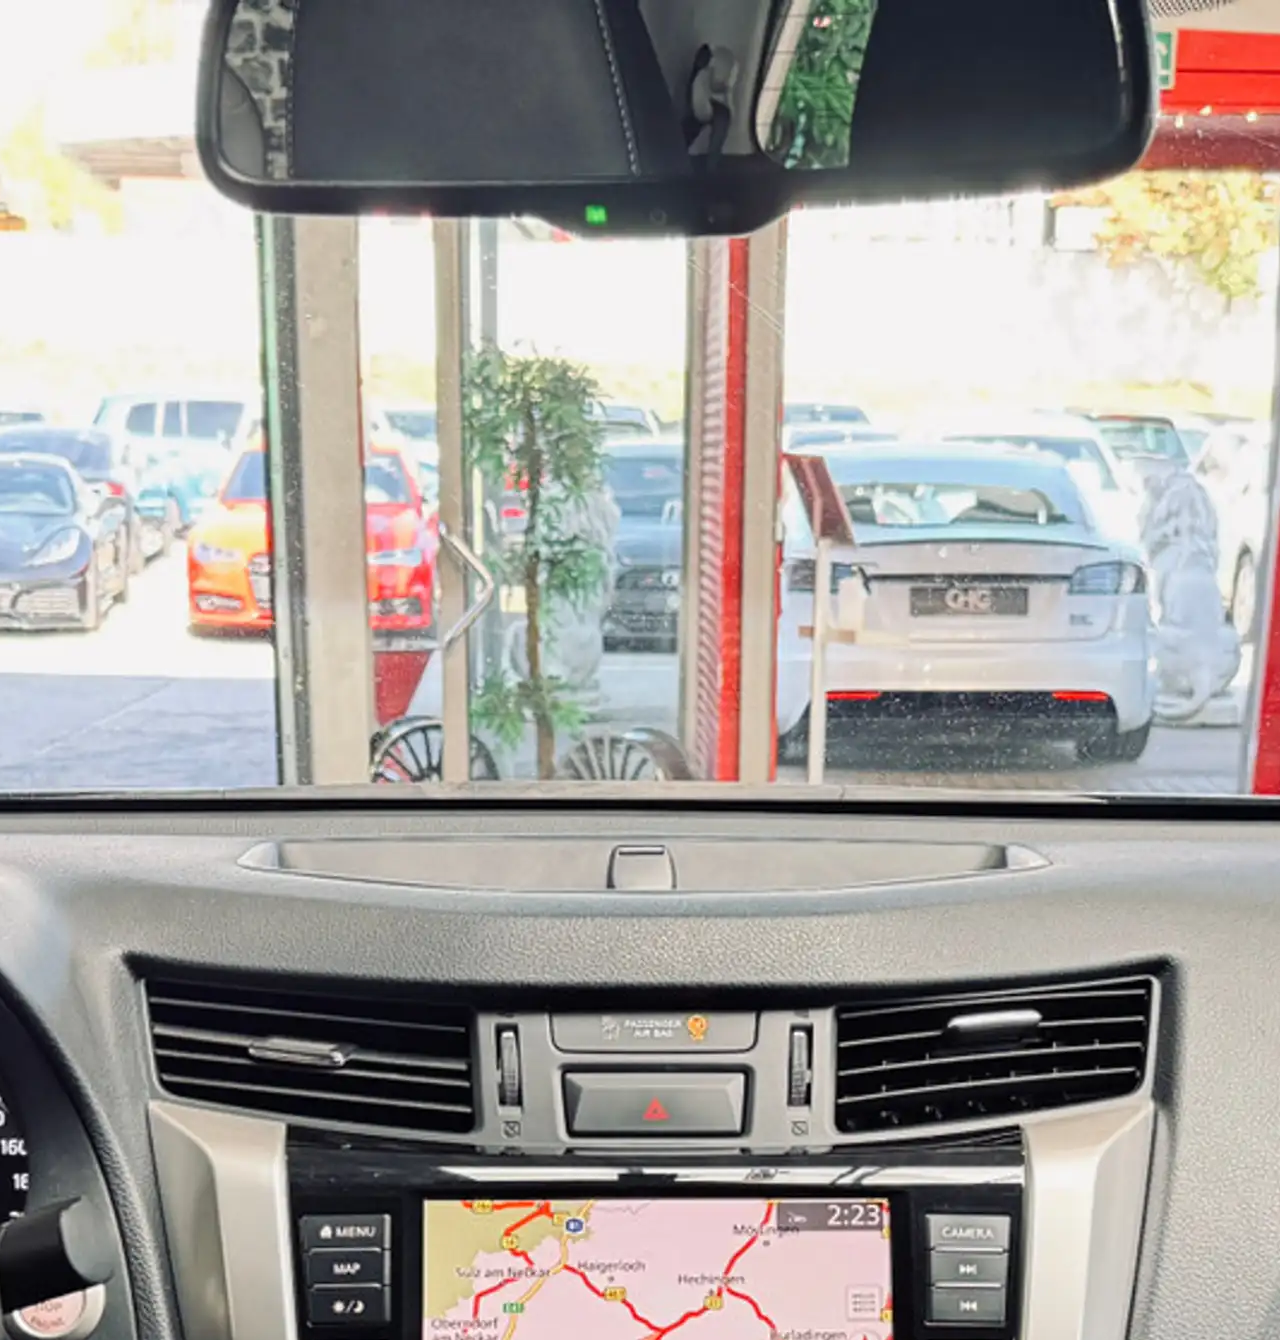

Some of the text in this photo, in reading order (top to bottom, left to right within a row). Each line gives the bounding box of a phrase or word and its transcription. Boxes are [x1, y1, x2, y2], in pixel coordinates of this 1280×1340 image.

[827, 1204, 881, 1226] 2:23
[334, 1226, 377, 1239] MENU
[941, 1226, 994, 1239] CAMERA
[333, 1263, 361, 1275] MAP
[484, 1269, 505, 1278] am
[577, 1260, 646, 1275] Haigerloch
[677, 1273, 745, 1287] Hechingen
